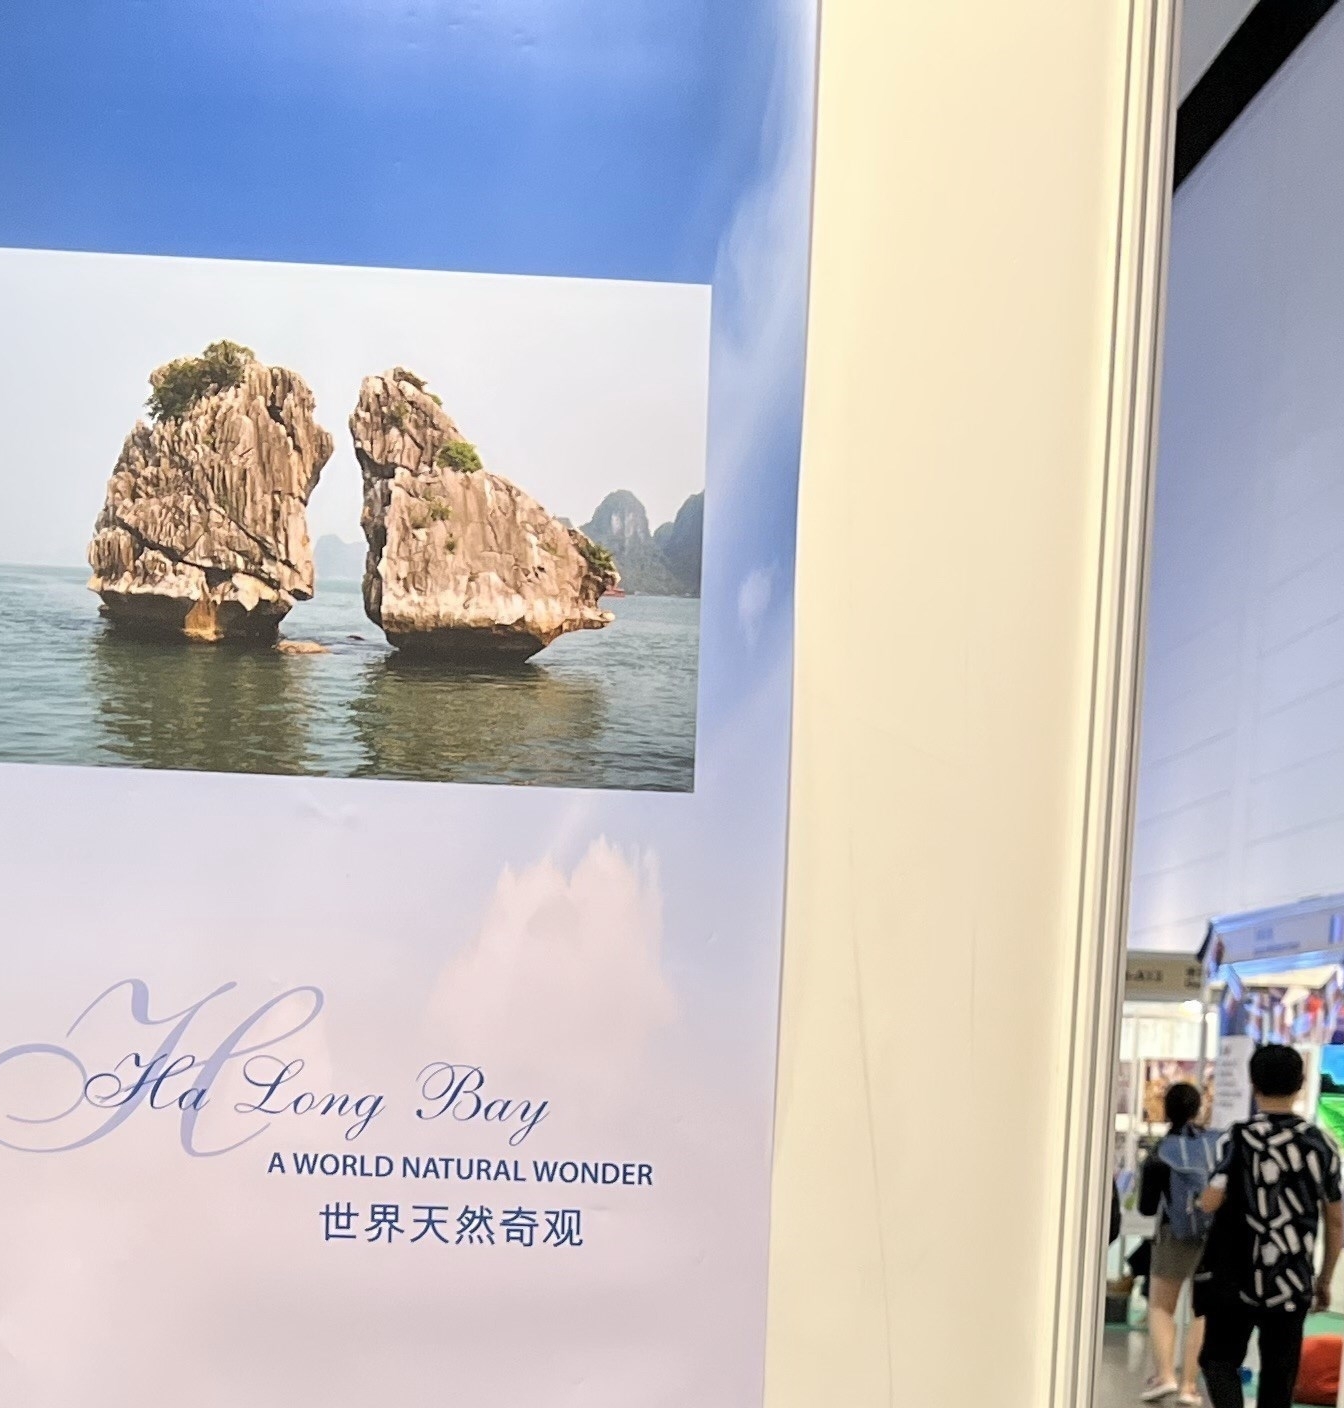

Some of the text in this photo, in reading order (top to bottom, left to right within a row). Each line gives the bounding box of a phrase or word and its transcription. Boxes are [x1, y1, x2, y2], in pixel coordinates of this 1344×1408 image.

[83, 1052, 551, 1147] Ha Long Bay
[267, 1152, 653, 1187] A WORLD NATURAL WONDER
[318, 1202, 584, 1248] 世界天然奇观
